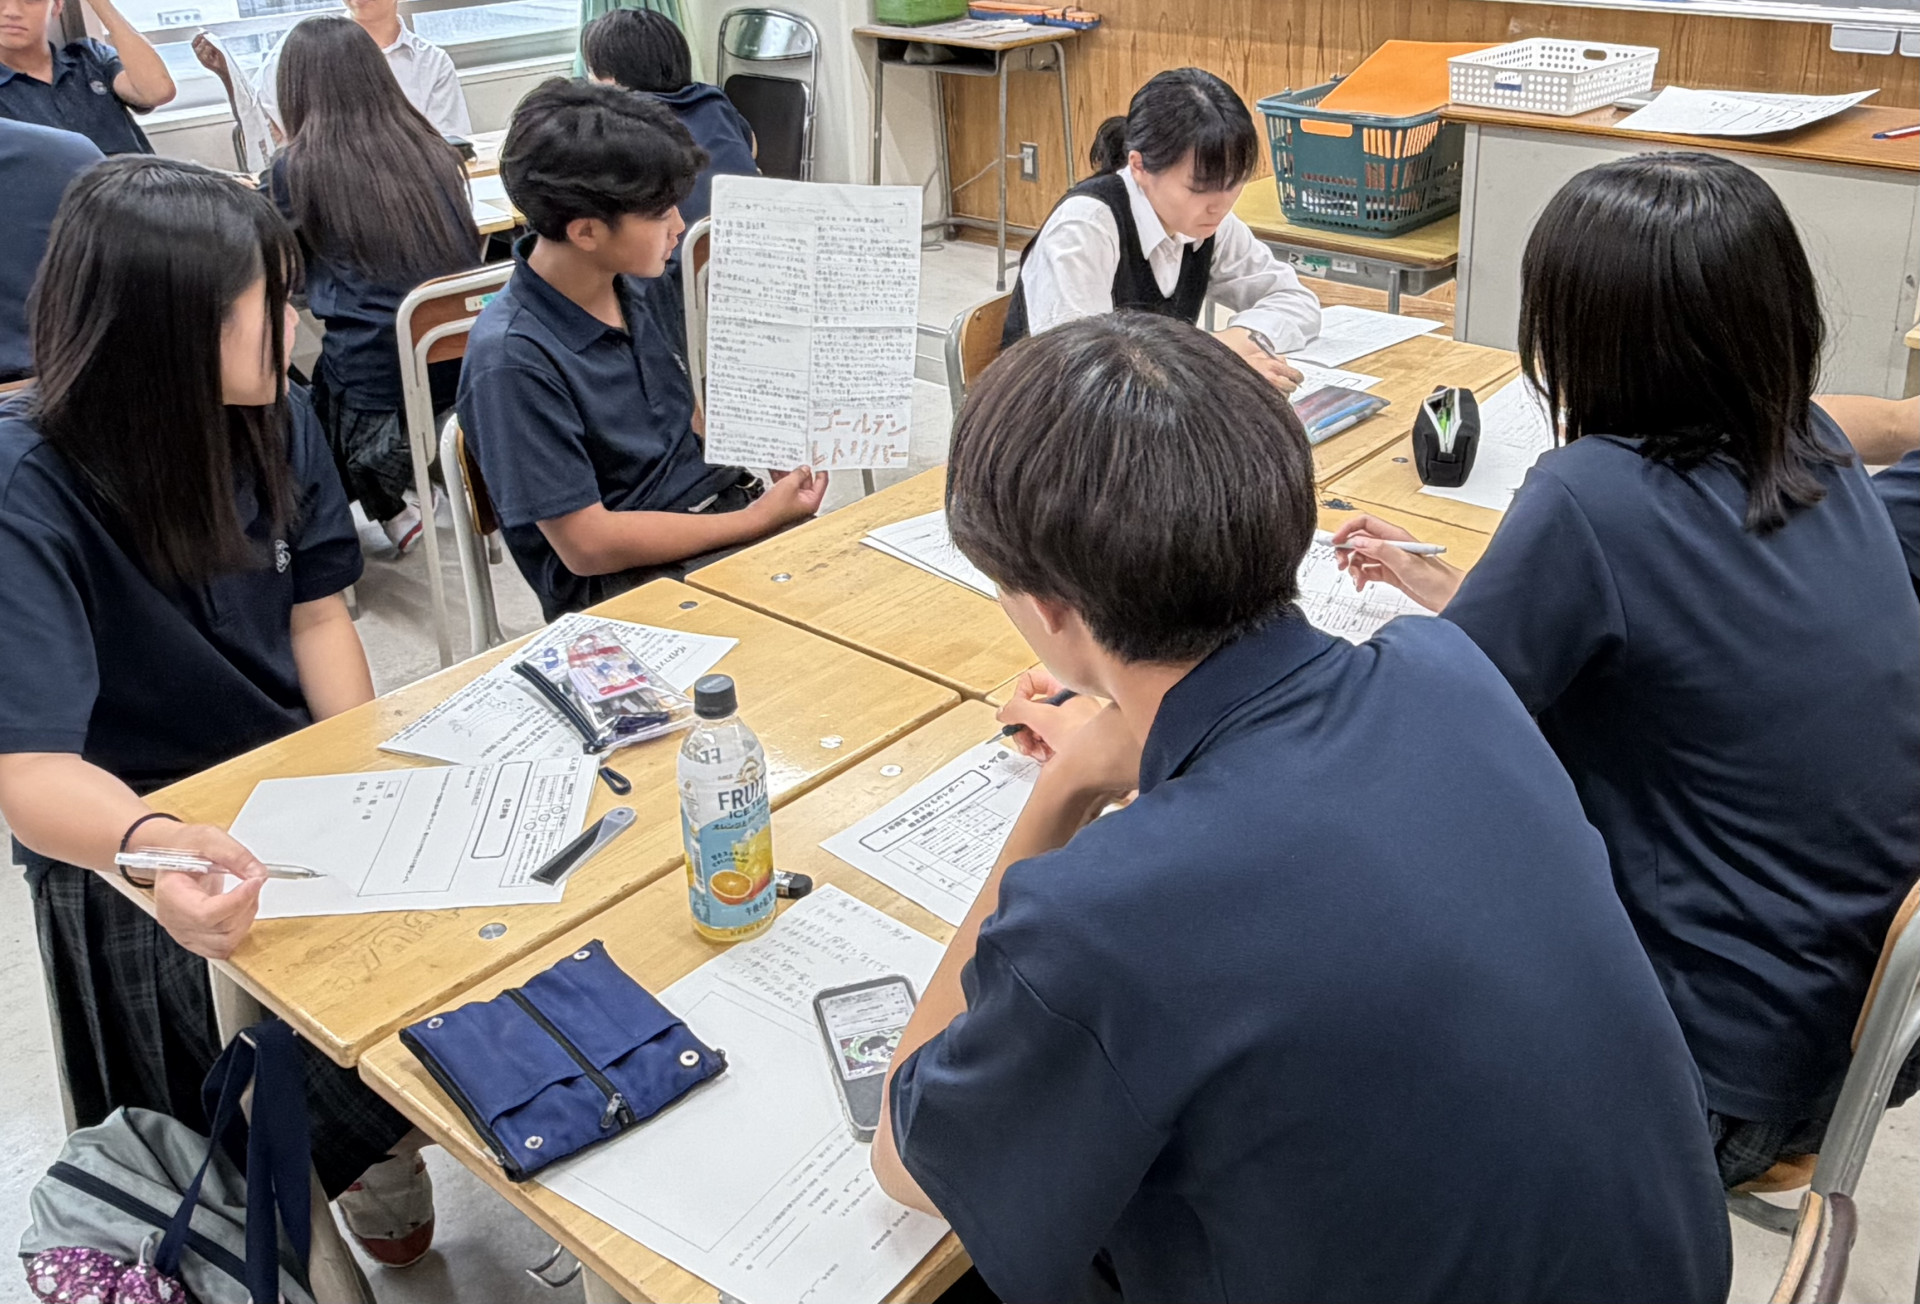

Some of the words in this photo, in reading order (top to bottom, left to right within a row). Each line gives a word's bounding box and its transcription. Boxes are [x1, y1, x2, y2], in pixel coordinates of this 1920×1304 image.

[813, 409, 907, 437] ゴールデン
[812, 438, 908, 466] レトリバー
[717, 774, 767, 811] FRUIT
[911, 780, 966, 816] 好きなものレポート
[728, 806, 750, 820] ICE
